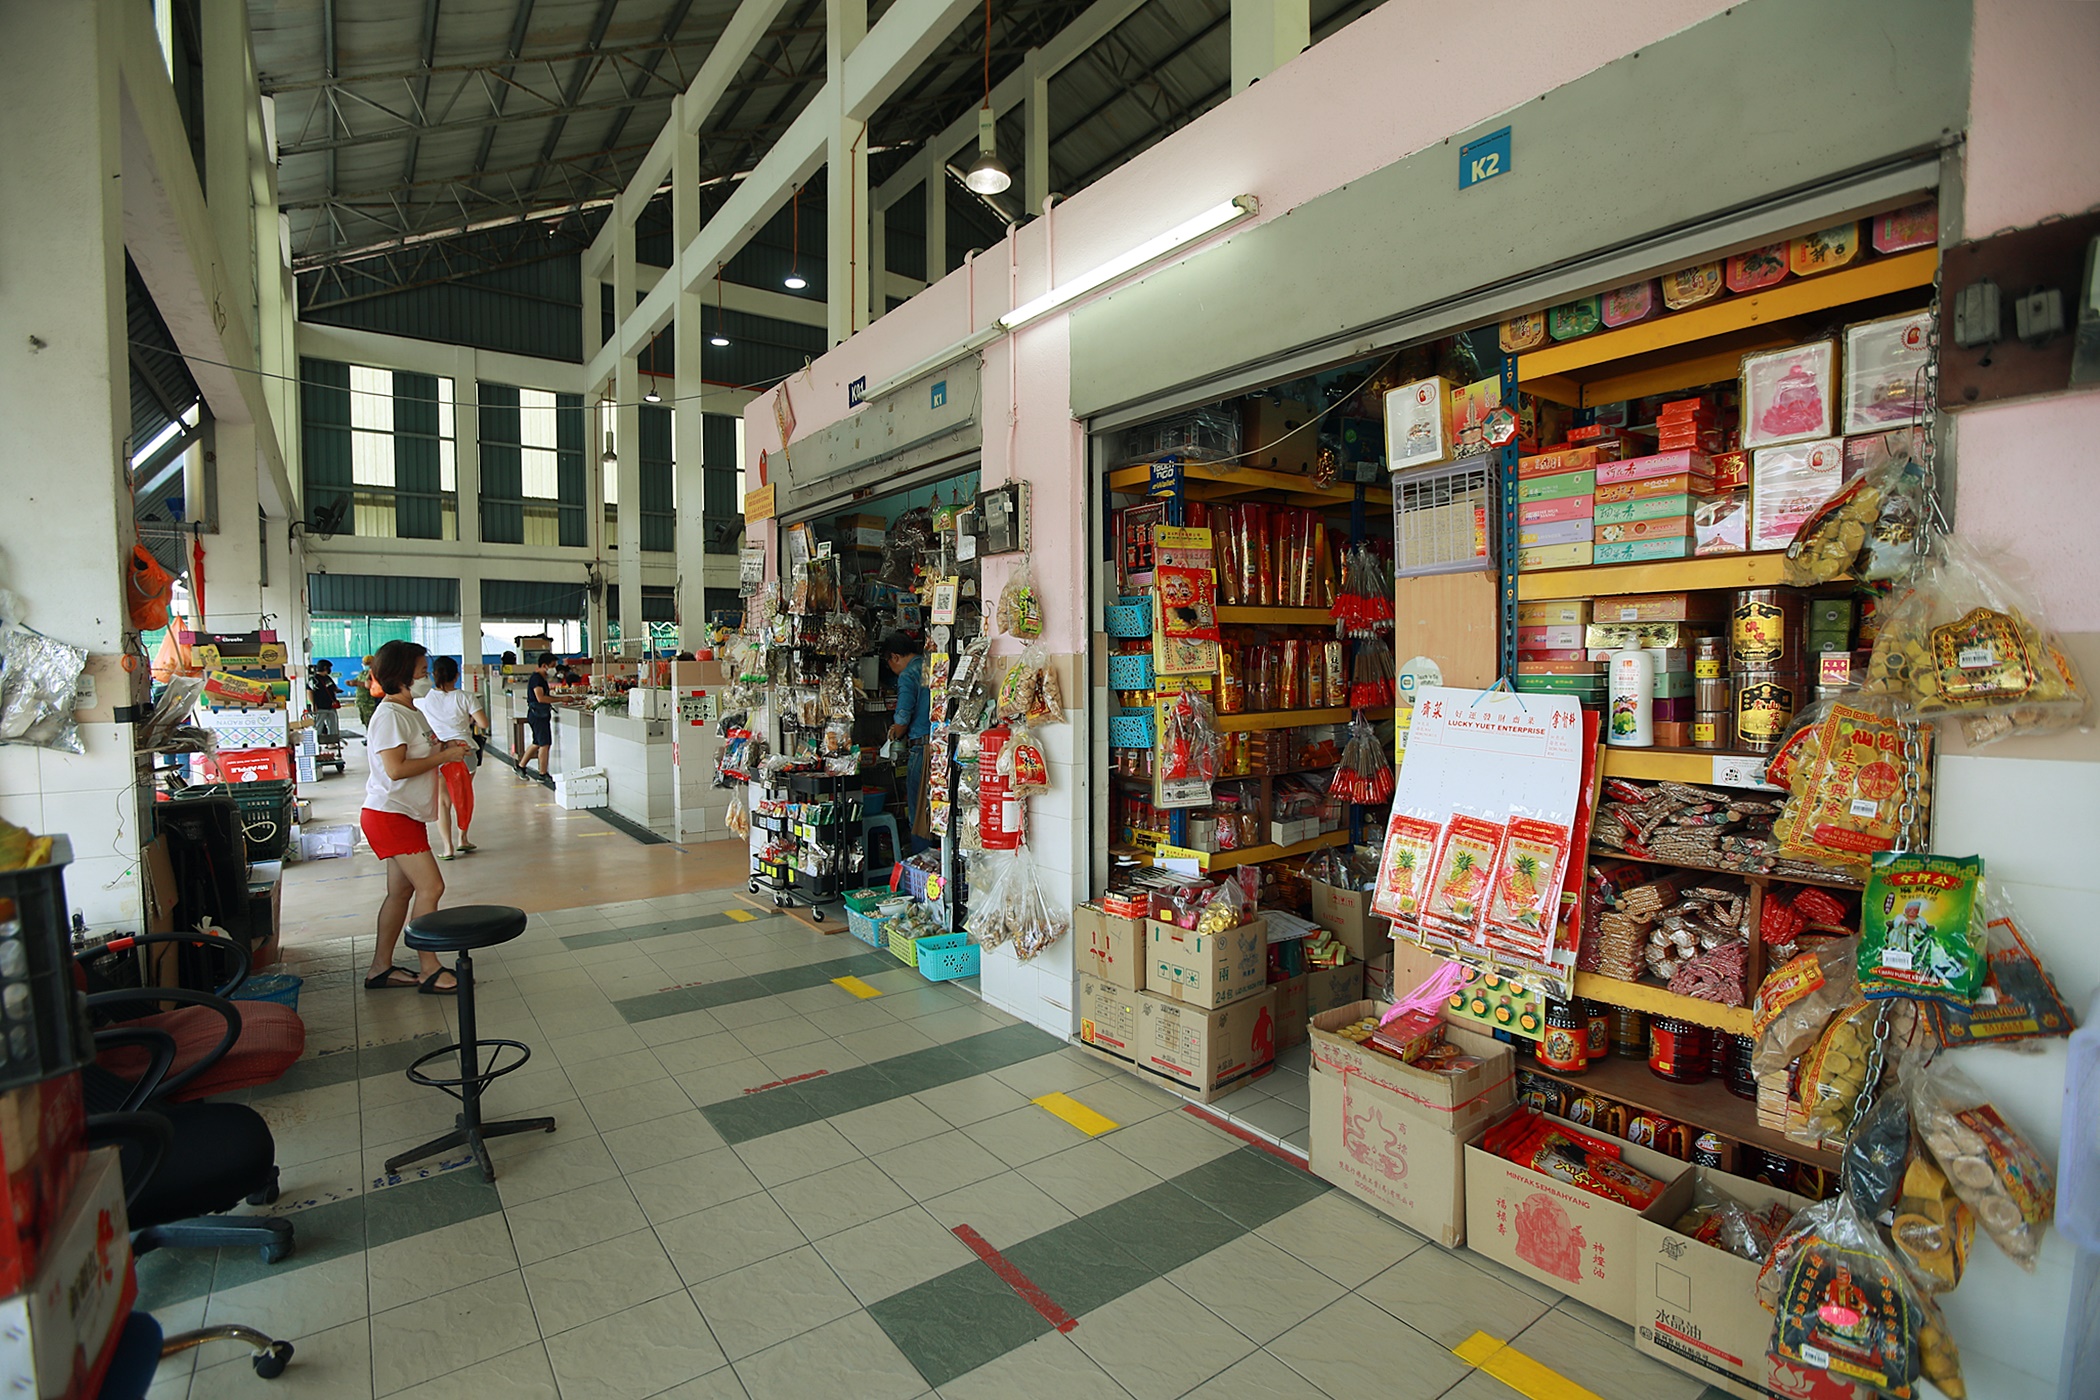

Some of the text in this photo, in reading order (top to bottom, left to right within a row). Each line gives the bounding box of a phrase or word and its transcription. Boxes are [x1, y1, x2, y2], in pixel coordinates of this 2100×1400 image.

[1472, 153, 1499, 183] K2
[934, 393, 943, 408] K1
[1448, 719, 1473, 728] LUCKY
[1475, 722, 1496, 731] YUET
[1497, 724, 1546, 736] ENTERPRISE
[1506, 1170, 1535, 1188] MINYAK
[1535, 1181, 1591, 1210] SEMBAHYANG
[1655, 1308, 1702, 1341] 水晶油
